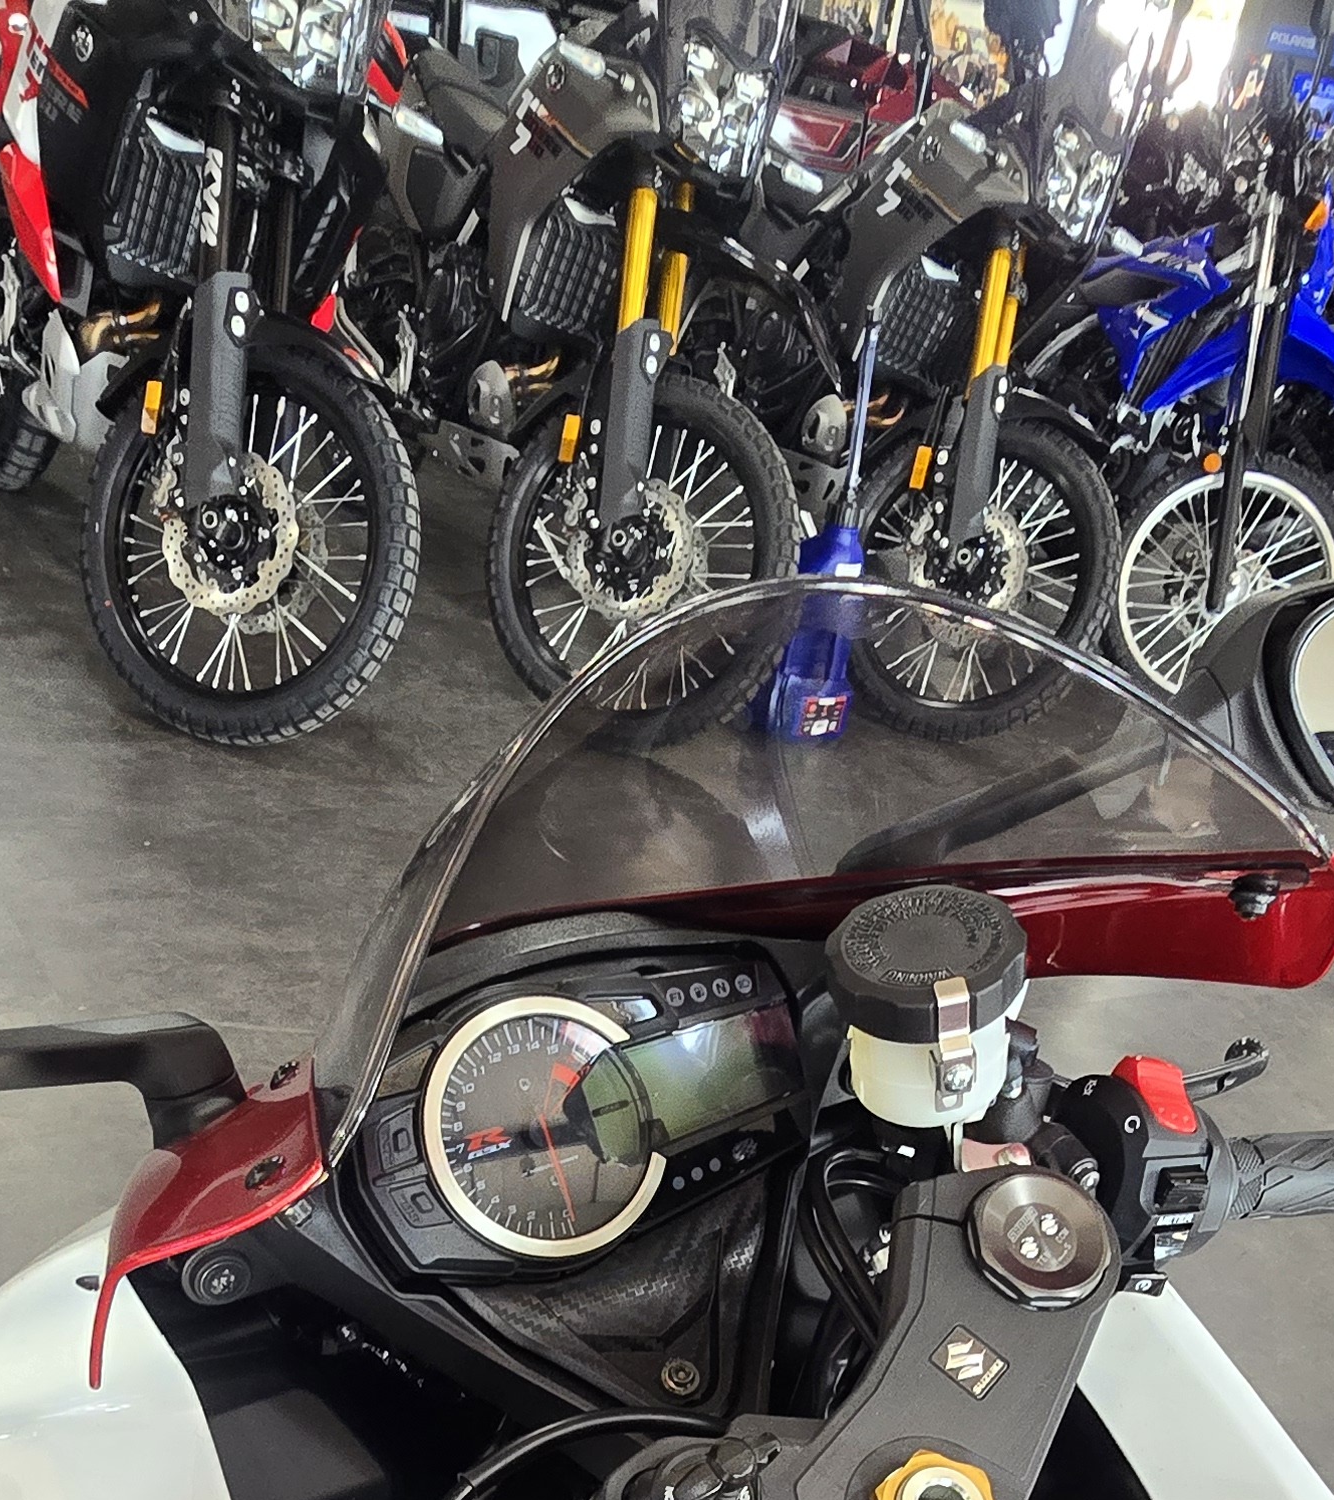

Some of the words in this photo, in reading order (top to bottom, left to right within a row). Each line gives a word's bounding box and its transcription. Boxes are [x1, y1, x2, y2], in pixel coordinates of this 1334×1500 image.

[1269, 31, 1317, 50] POLARIS
[715, 982, 727, 995] N
[506, 1043, 521, 1056] 13
[525, 1040, 541, 1052] 14
[546, 1043, 559, 1055] 15
[487, 1052, 502, 1064] 12
[471, 1066, 485, 1077] 11
[461, 1083, 475, 1095] 10
[455, 1101, 466, 1112] 9
[453, 1122, 463, 1132] 8
[453, 1143, 465, 1154] 7
[463, 1162, 473, 1173] 6
[490, 1194, 500, 1205] 4
[508, 1205, 517, 1214] 3
[526, 1211, 536, 1221] 2
[548, 1211, 554, 1220] 1
